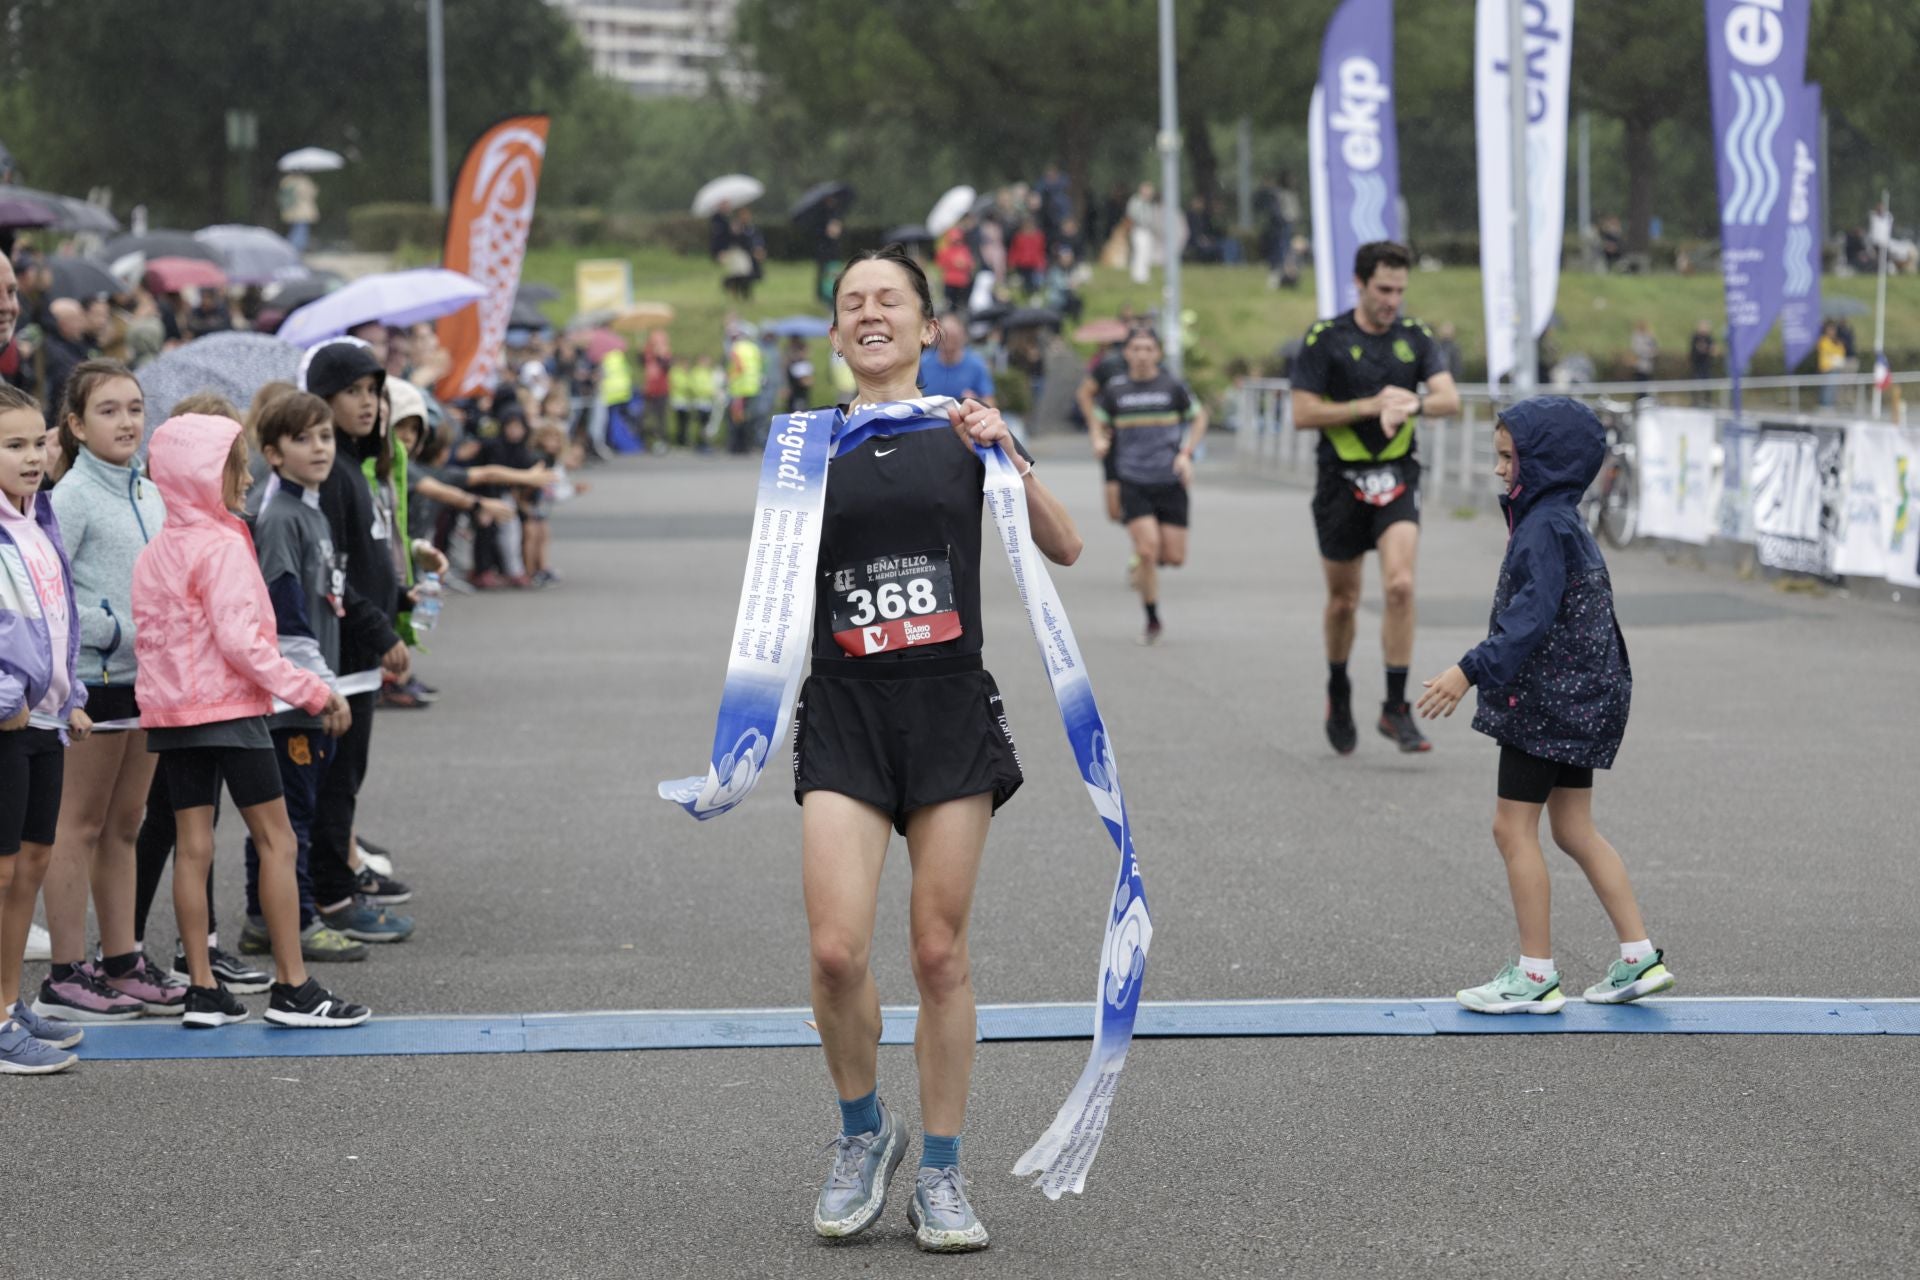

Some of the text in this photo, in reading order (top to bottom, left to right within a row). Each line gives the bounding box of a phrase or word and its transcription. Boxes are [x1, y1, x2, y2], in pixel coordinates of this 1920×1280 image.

[1724, 0, 1784, 66] e
[1329, 55, 1391, 172] ekp
[999, 487, 1015, 520] Txingudi
[760, 506, 775, 540] Consorcio
[776, 510, 791, 541] Consorcio
[794, 512, 808, 535] Bidasoa
[1008, 526, 1020, 554] Bidasoa
[752, 543, 770, 592] Transfrontalier
[767, 544, 786, 594] Transfronterizo
[787, 543, 803, 569] Txingudi
[867, 555, 928, 575] BEÑAT ELZO
[783, 570, 798, 591] Mugaz
[875, 570, 897, 580] MENDI
[898, 564, 937, 577] LASTERKETA
[745, 595, 760, 620] Bidasoa
[762, 597, 777, 623] Bidasoa
[846, 578, 937, 626] 368
[738, 629, 755, 658] Txingudi
[768, 624, 790, 664] Partzuergoa
[904, 624, 930, 635] DIARIO
[906, 631, 931, 641] VASCO
[754, 631, 771, 661] Txingudi
